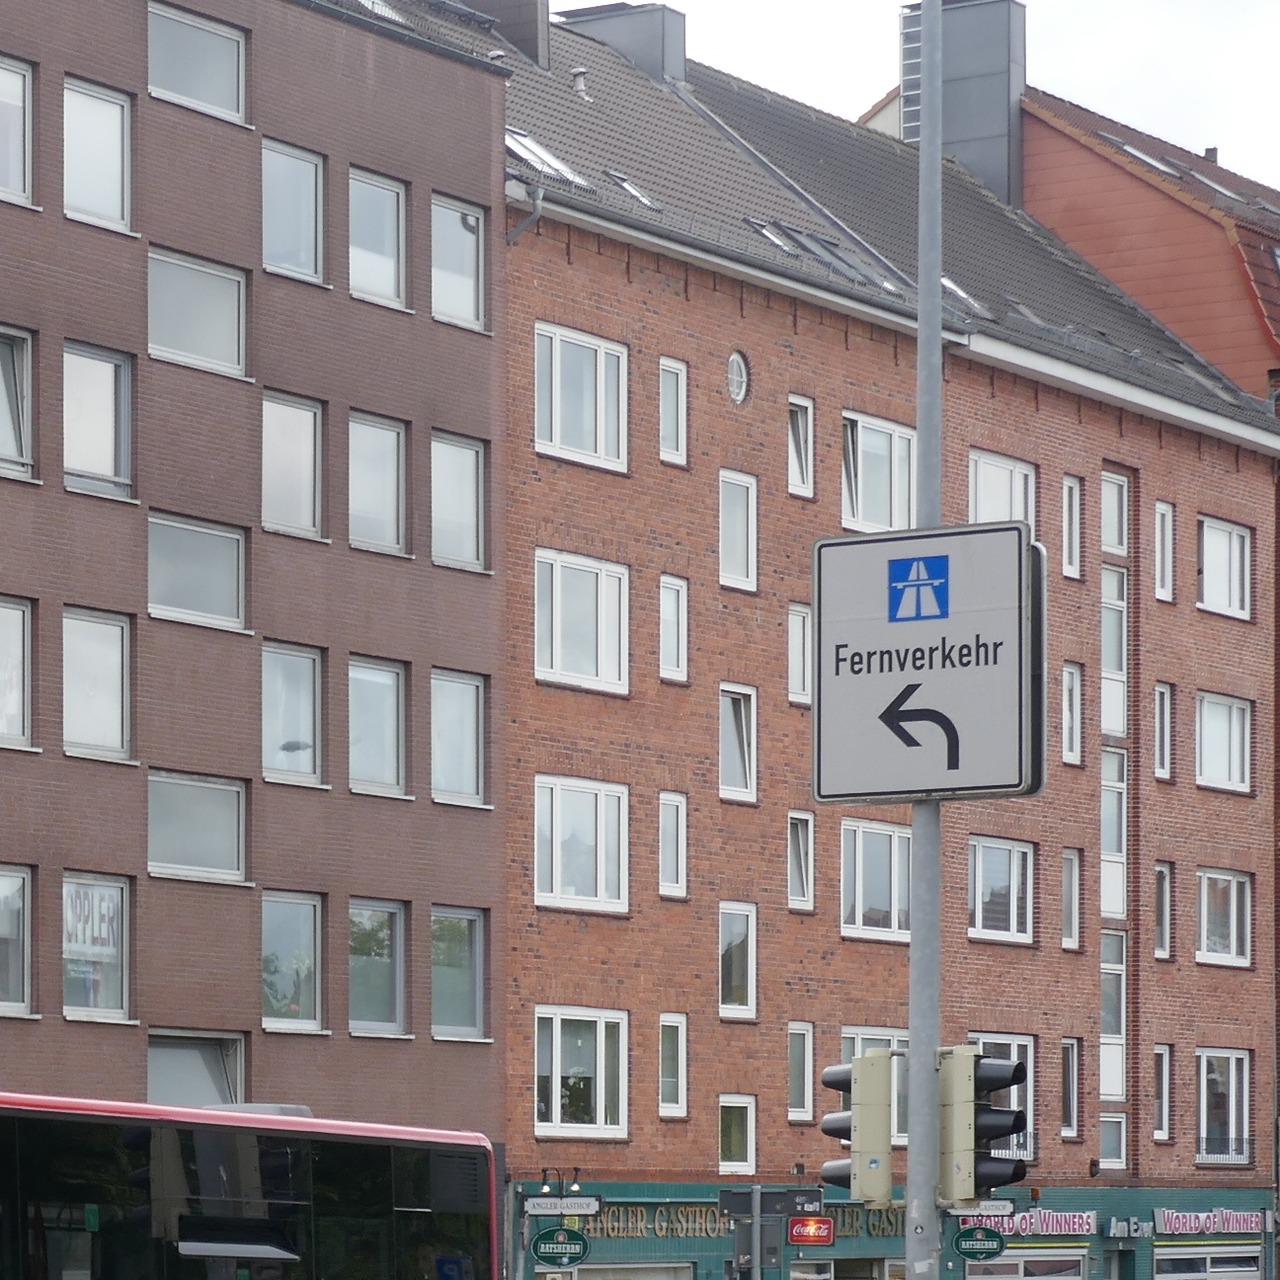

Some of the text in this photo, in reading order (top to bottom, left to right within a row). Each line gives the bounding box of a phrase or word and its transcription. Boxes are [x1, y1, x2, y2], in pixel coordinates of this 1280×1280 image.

[834, 634, 1004, 676] Fernverkehr
[531, 1202, 591, 1211] ANGLER GASTHOF
[793, 1223, 829, 1237] Coca-Cola
[1019, 1214, 1035, 1234] OF
[1040, 1211, 1091, 1234] WINNERS
[1163, 1210, 1200, 1233] WORLD
[1205, 1213, 1218, 1233] OF
[539, 1243, 581, 1253] RATSHERRN
